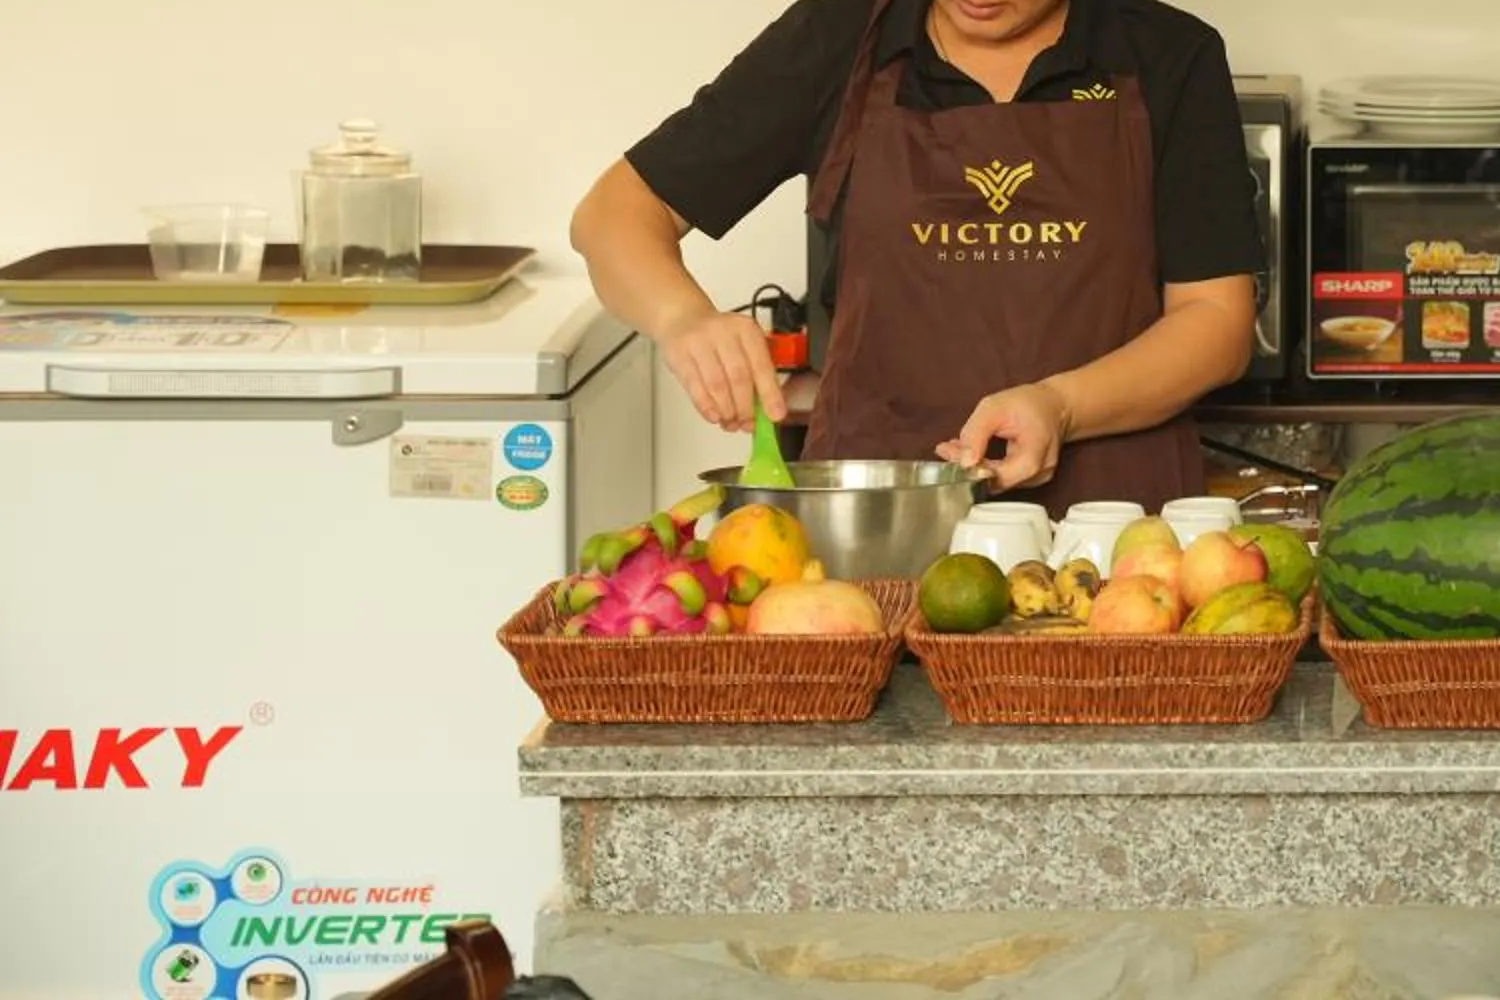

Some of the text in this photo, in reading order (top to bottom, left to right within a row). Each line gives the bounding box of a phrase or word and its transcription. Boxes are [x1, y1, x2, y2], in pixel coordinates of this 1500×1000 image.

[911, 221, 1088, 245] VICTORY
[937, 250, 1062, 262] HOMESTAY
[1320, 279, 1394, 293] SHARP
[365, 884, 435, 907] NGHỆ
[229, 912, 492, 947] INVERTE
